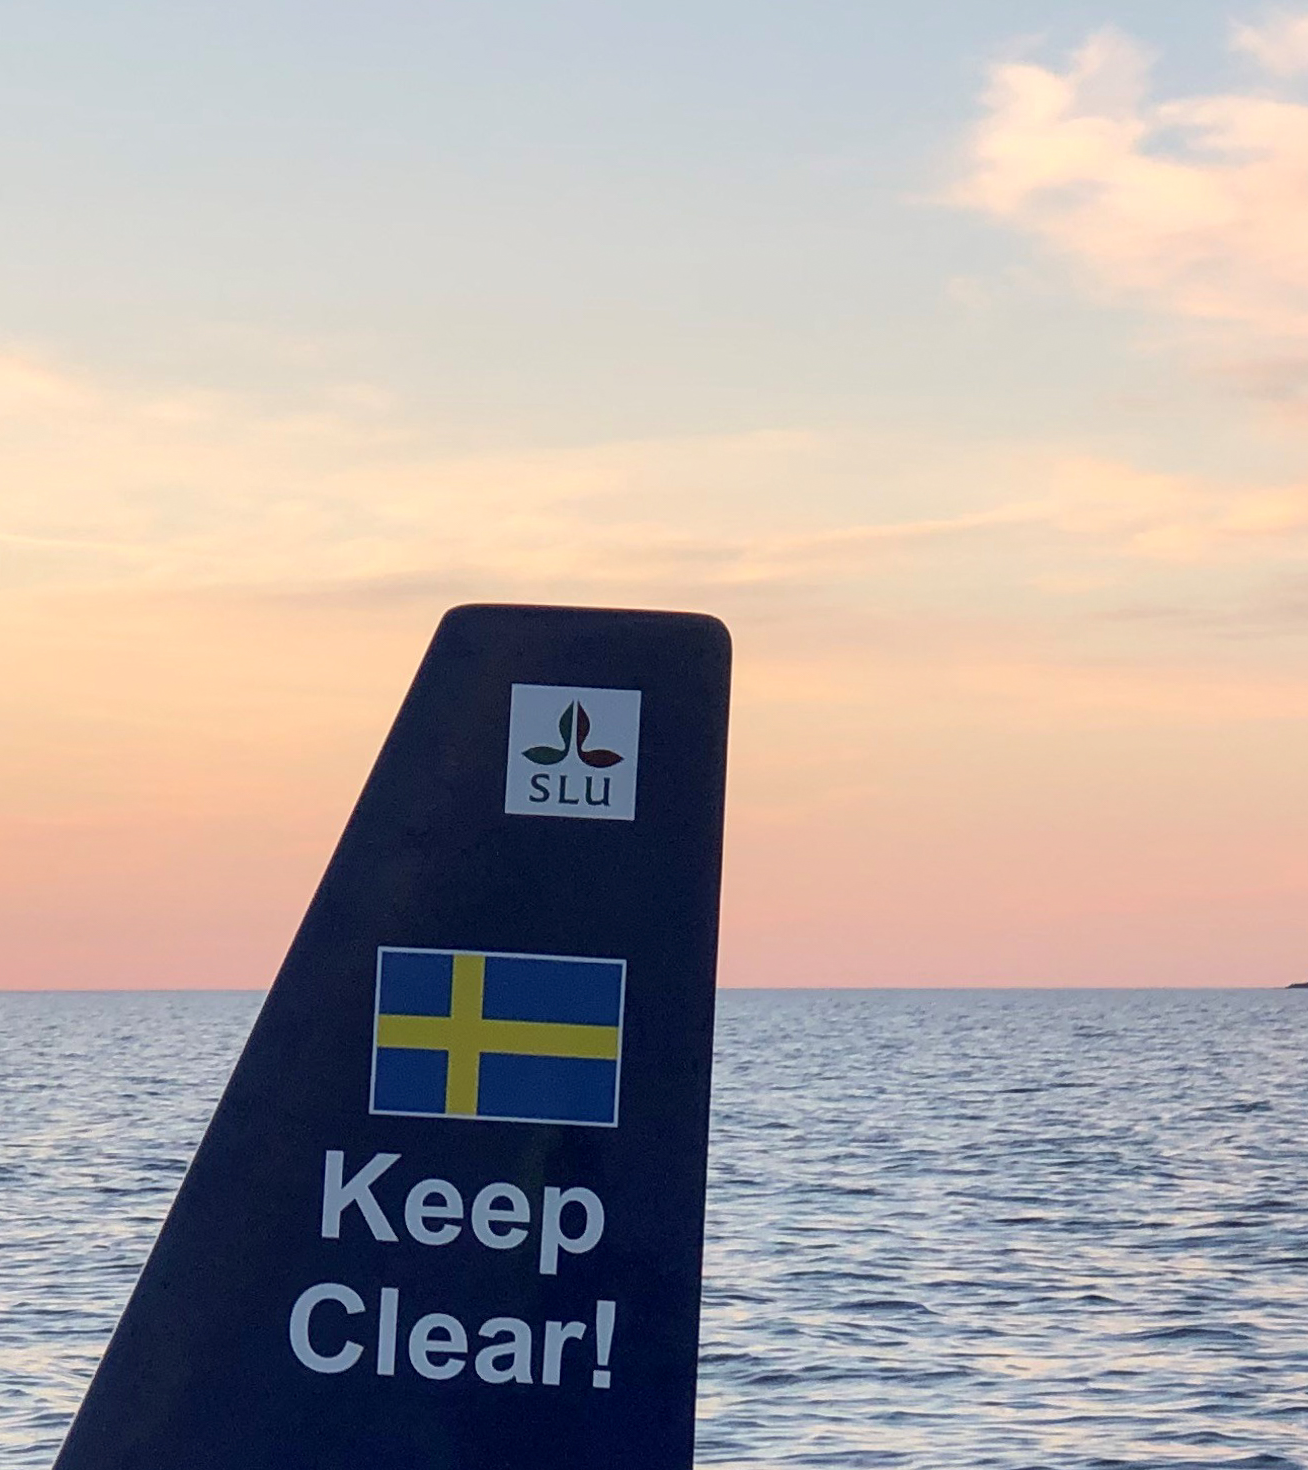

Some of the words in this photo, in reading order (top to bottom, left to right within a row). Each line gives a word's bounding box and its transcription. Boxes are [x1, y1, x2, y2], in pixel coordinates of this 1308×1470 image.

[528, 773, 611, 807] SLU
[321, 1149, 605, 1275] Keep
[289, 1282, 617, 1389] Clear!
